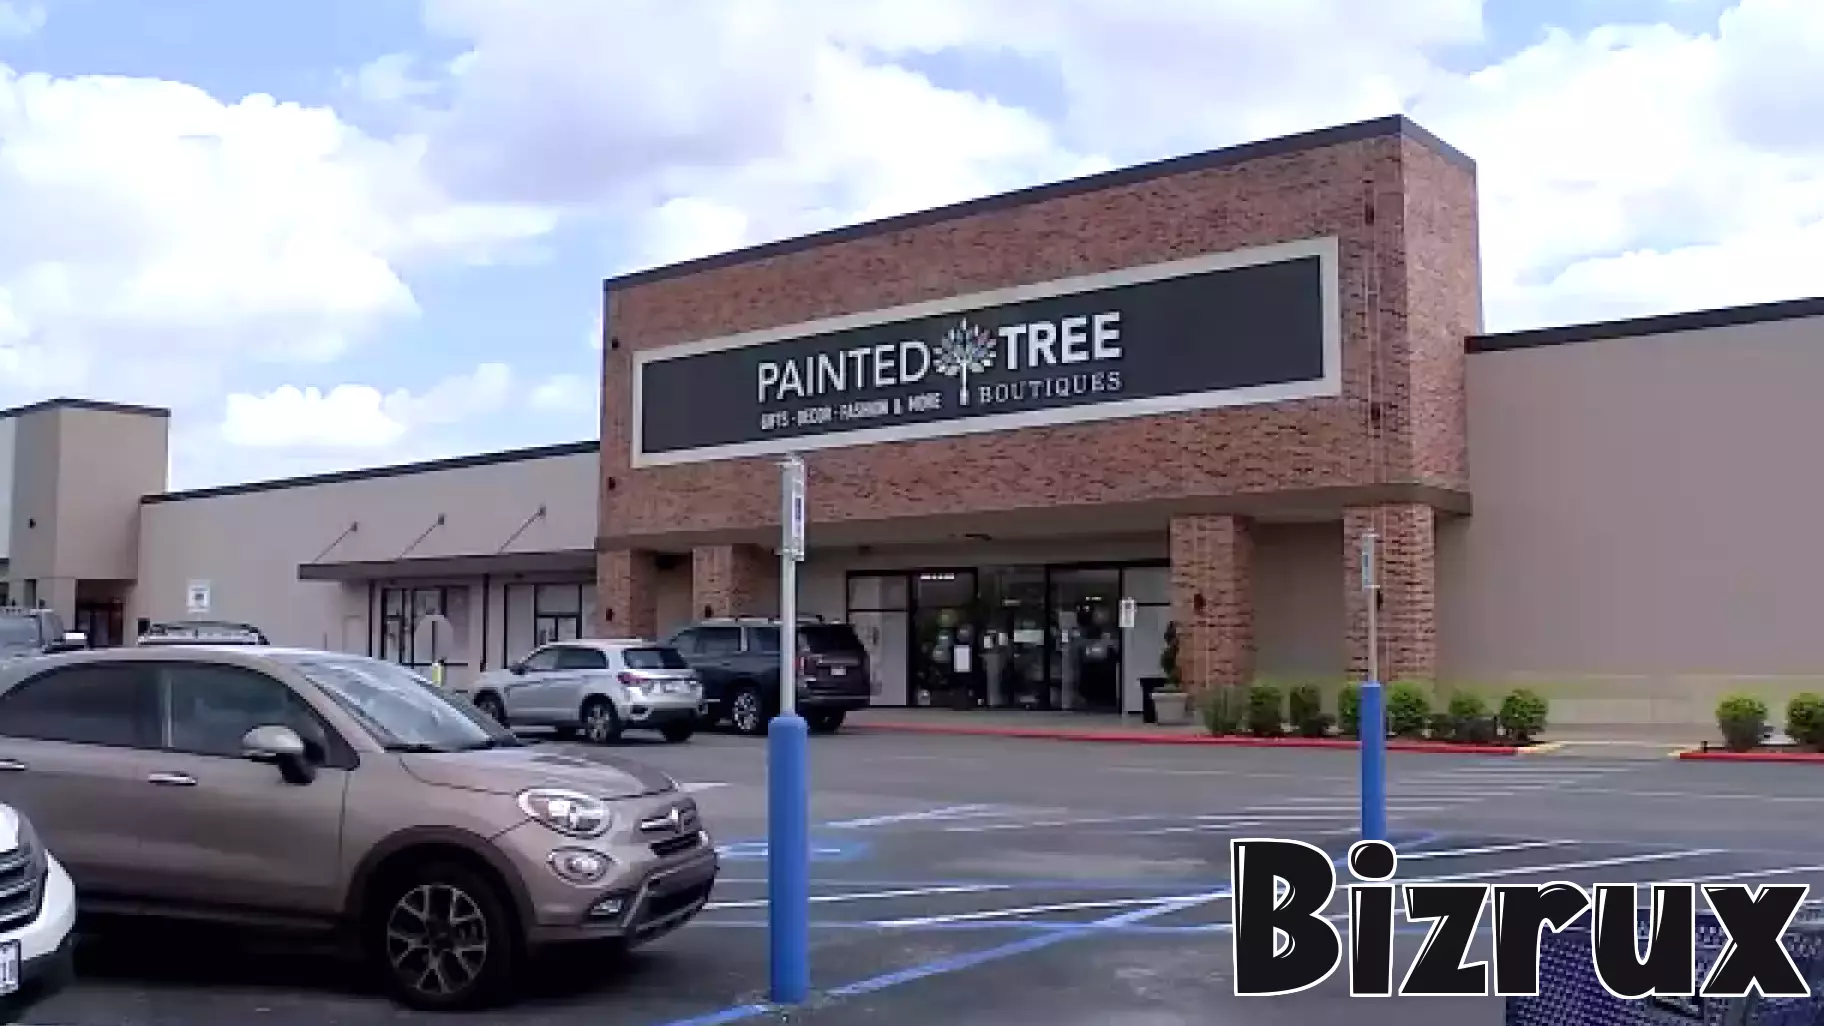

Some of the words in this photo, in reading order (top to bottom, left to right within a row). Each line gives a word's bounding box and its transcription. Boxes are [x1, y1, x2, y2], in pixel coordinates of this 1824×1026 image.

[757, 340, 931, 404] PAINTED
[999, 312, 1123, 370] TREE
[979, 370, 1123, 404] BOUTIQUES
